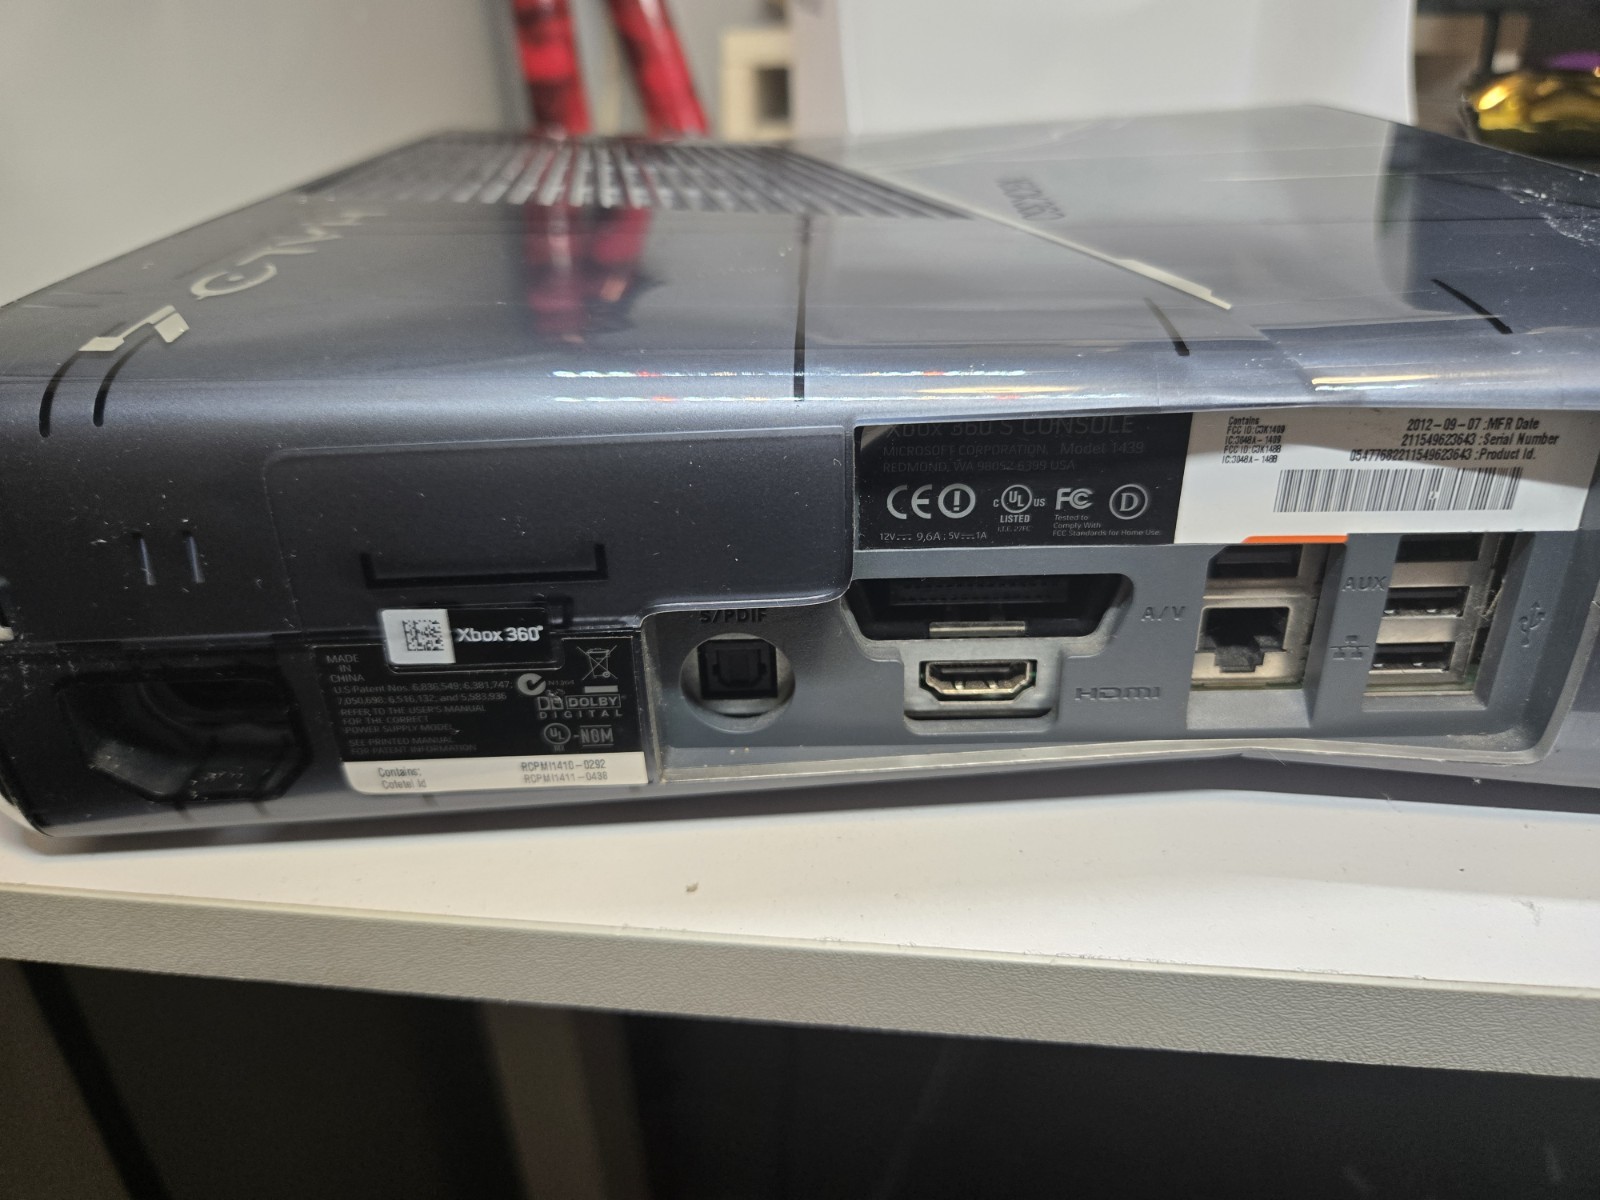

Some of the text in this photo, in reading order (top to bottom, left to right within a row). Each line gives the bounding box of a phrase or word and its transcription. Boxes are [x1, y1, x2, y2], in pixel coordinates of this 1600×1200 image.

[999, 420, 1013, 435] S
[1023, 416, 1134, 435] CONSOLE
[1228, 416, 1260, 425] Contains
[1515, 417, 1540, 430] Date
[1226, 425, 1242, 434] FCC
[1401, 433, 1476, 447] 211549623643
[1517, 433, 1560, 446] Number
[883, 445, 957, 456] MICROSOFT
[1060, 442, 1106, 455] Model
[1112, 441, 1145, 454] 1439
[1223, 445, 1238, 454] FCC
[883, 461, 950, 473] REDMOND,
[953, 461, 974, 472] WA
[1050, 460, 1076, 471] USA
[1000, 514, 1031, 524] LISTED
[1053, 521, 1102, 530] Comply With
[880, 532, 896, 541] 12V
[948, 531, 961, 540] 5V
[976, 531, 988, 539] 1A
[1052, 529, 1067, 537] FCC
[1068, 529, 1107, 537] Standards
[1121, 528, 1143, 536] Home
[1341, 576, 1387, 592] AUX
[699, 609, 767, 623] S/PDIF
[1140, 605, 1186, 622] A/V
[457, 627, 503, 643] Xbox
[326, 654, 360, 664] MADE
[338, 664, 351, 673] IN
[330, 673, 365, 683] CHINA
[352, 685, 385, 694] Patent
[1074, 686, 1161, 701] HDMI
[440, 693, 459, 702] and
[568, 696, 618, 708] DOLBY
[341, 704, 487, 717] REFER TO THE USER'S MANUAL
[539, 709, 623, 720] DIGITAL
[343, 715, 429, 726] FOR THE CORRECT
[344, 723, 453, 734] POWER SUPPLY MODEL
[368, 737, 410, 746] PRINTED
[412, 736, 454, 745] MANUAL
[372, 745, 408, 754] PATENT
[410, 743, 478, 753] INFORMATION
